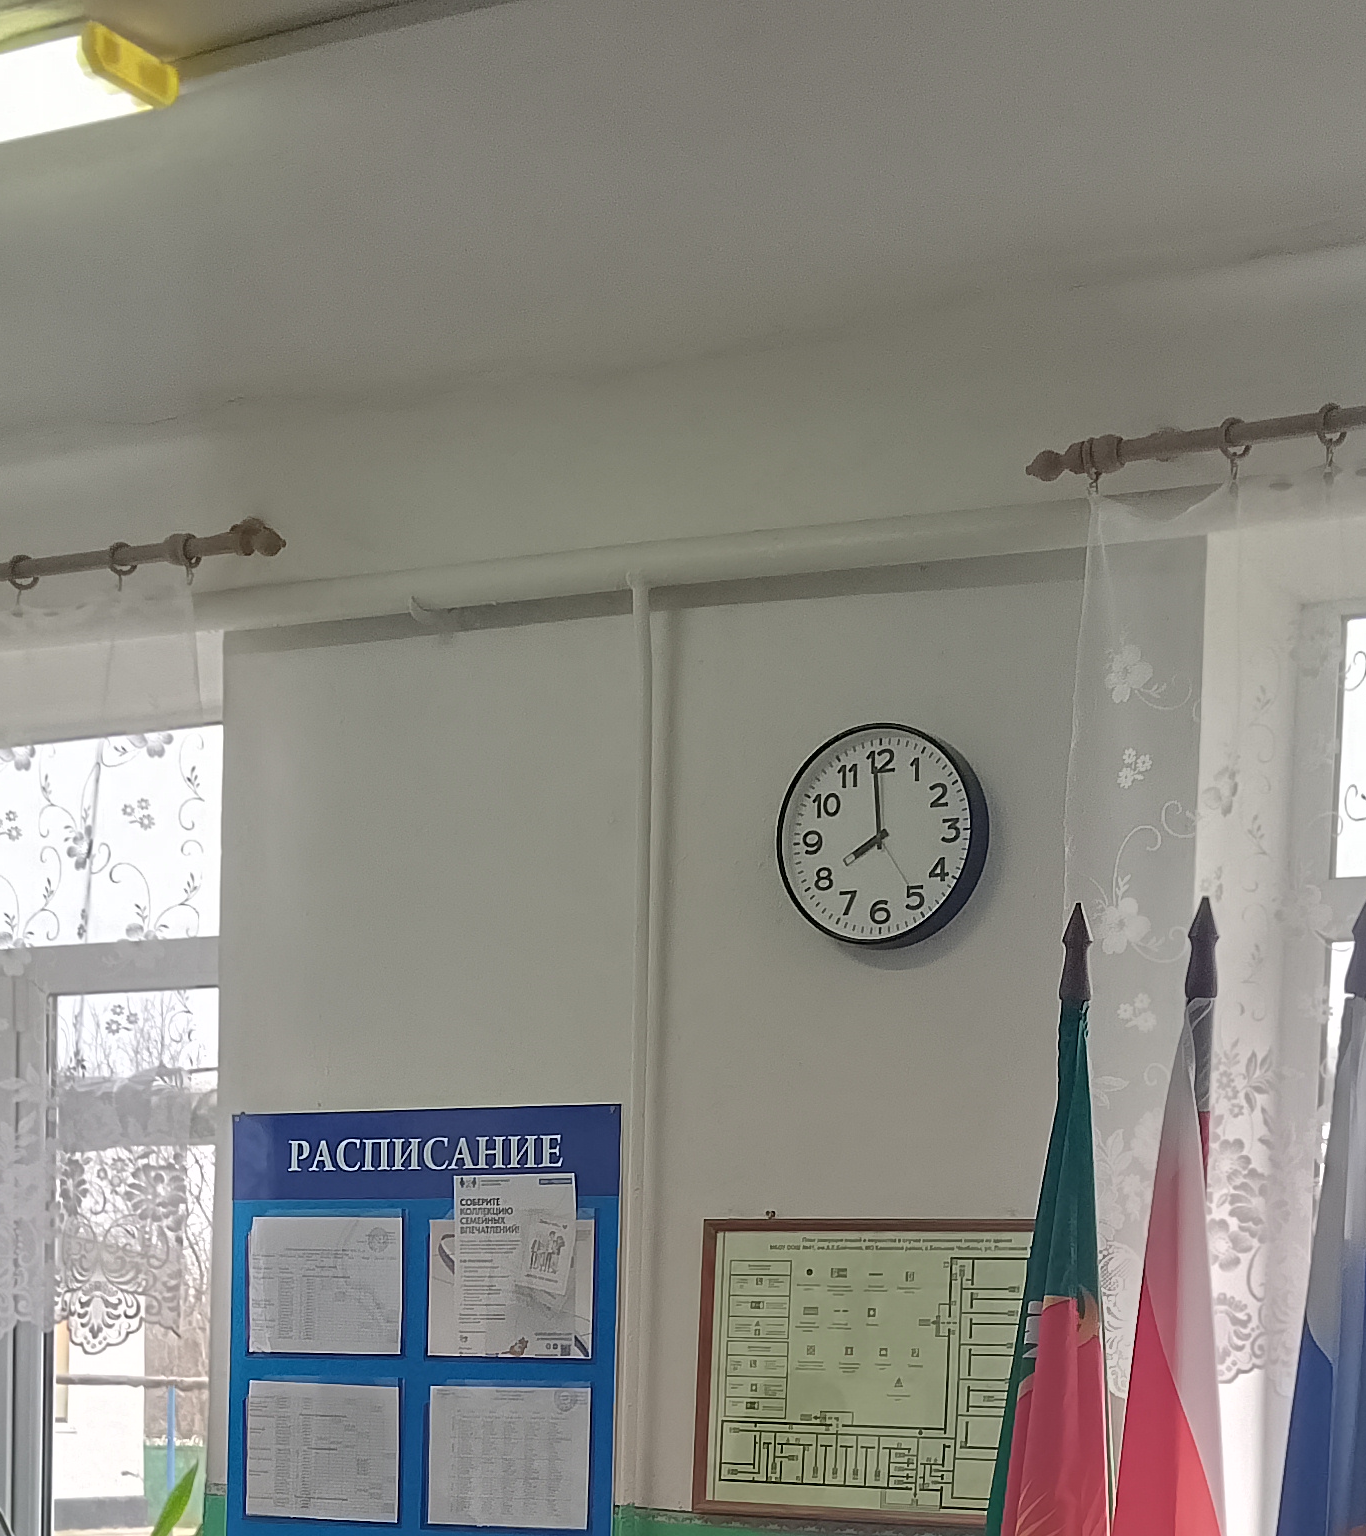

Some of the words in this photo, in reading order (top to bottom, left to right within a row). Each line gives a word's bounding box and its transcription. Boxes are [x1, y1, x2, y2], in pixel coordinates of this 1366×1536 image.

[866, 748, 896, 774] 12
[910, 757, 920, 782] 1
[837, 763, 858, 788] 11
[812, 792, 841, 818] 10
[929, 782, 949, 808] 2
[802, 830, 823, 855] 9
[940, 817, 961, 843] 3
[814, 866, 834, 891] 8
[928, 856, 949, 882] 4
[838, 890, 858, 916] 7
[905, 884, 925, 911] 5
[869, 899, 891, 925] 6
[287, 1133, 564, 1174] РАСПИСАНИЕ
[459, 1197, 501, 1207] СОБЕРИТЕ
[459, 1207, 514, 1216] КОЛЛЕКЦИЮ
[459, 1216, 506, 1225] СЕМЕЙНЫХ
[459, 1224, 520, 1234] ВПЕЧАТЛЕНИЙ!
